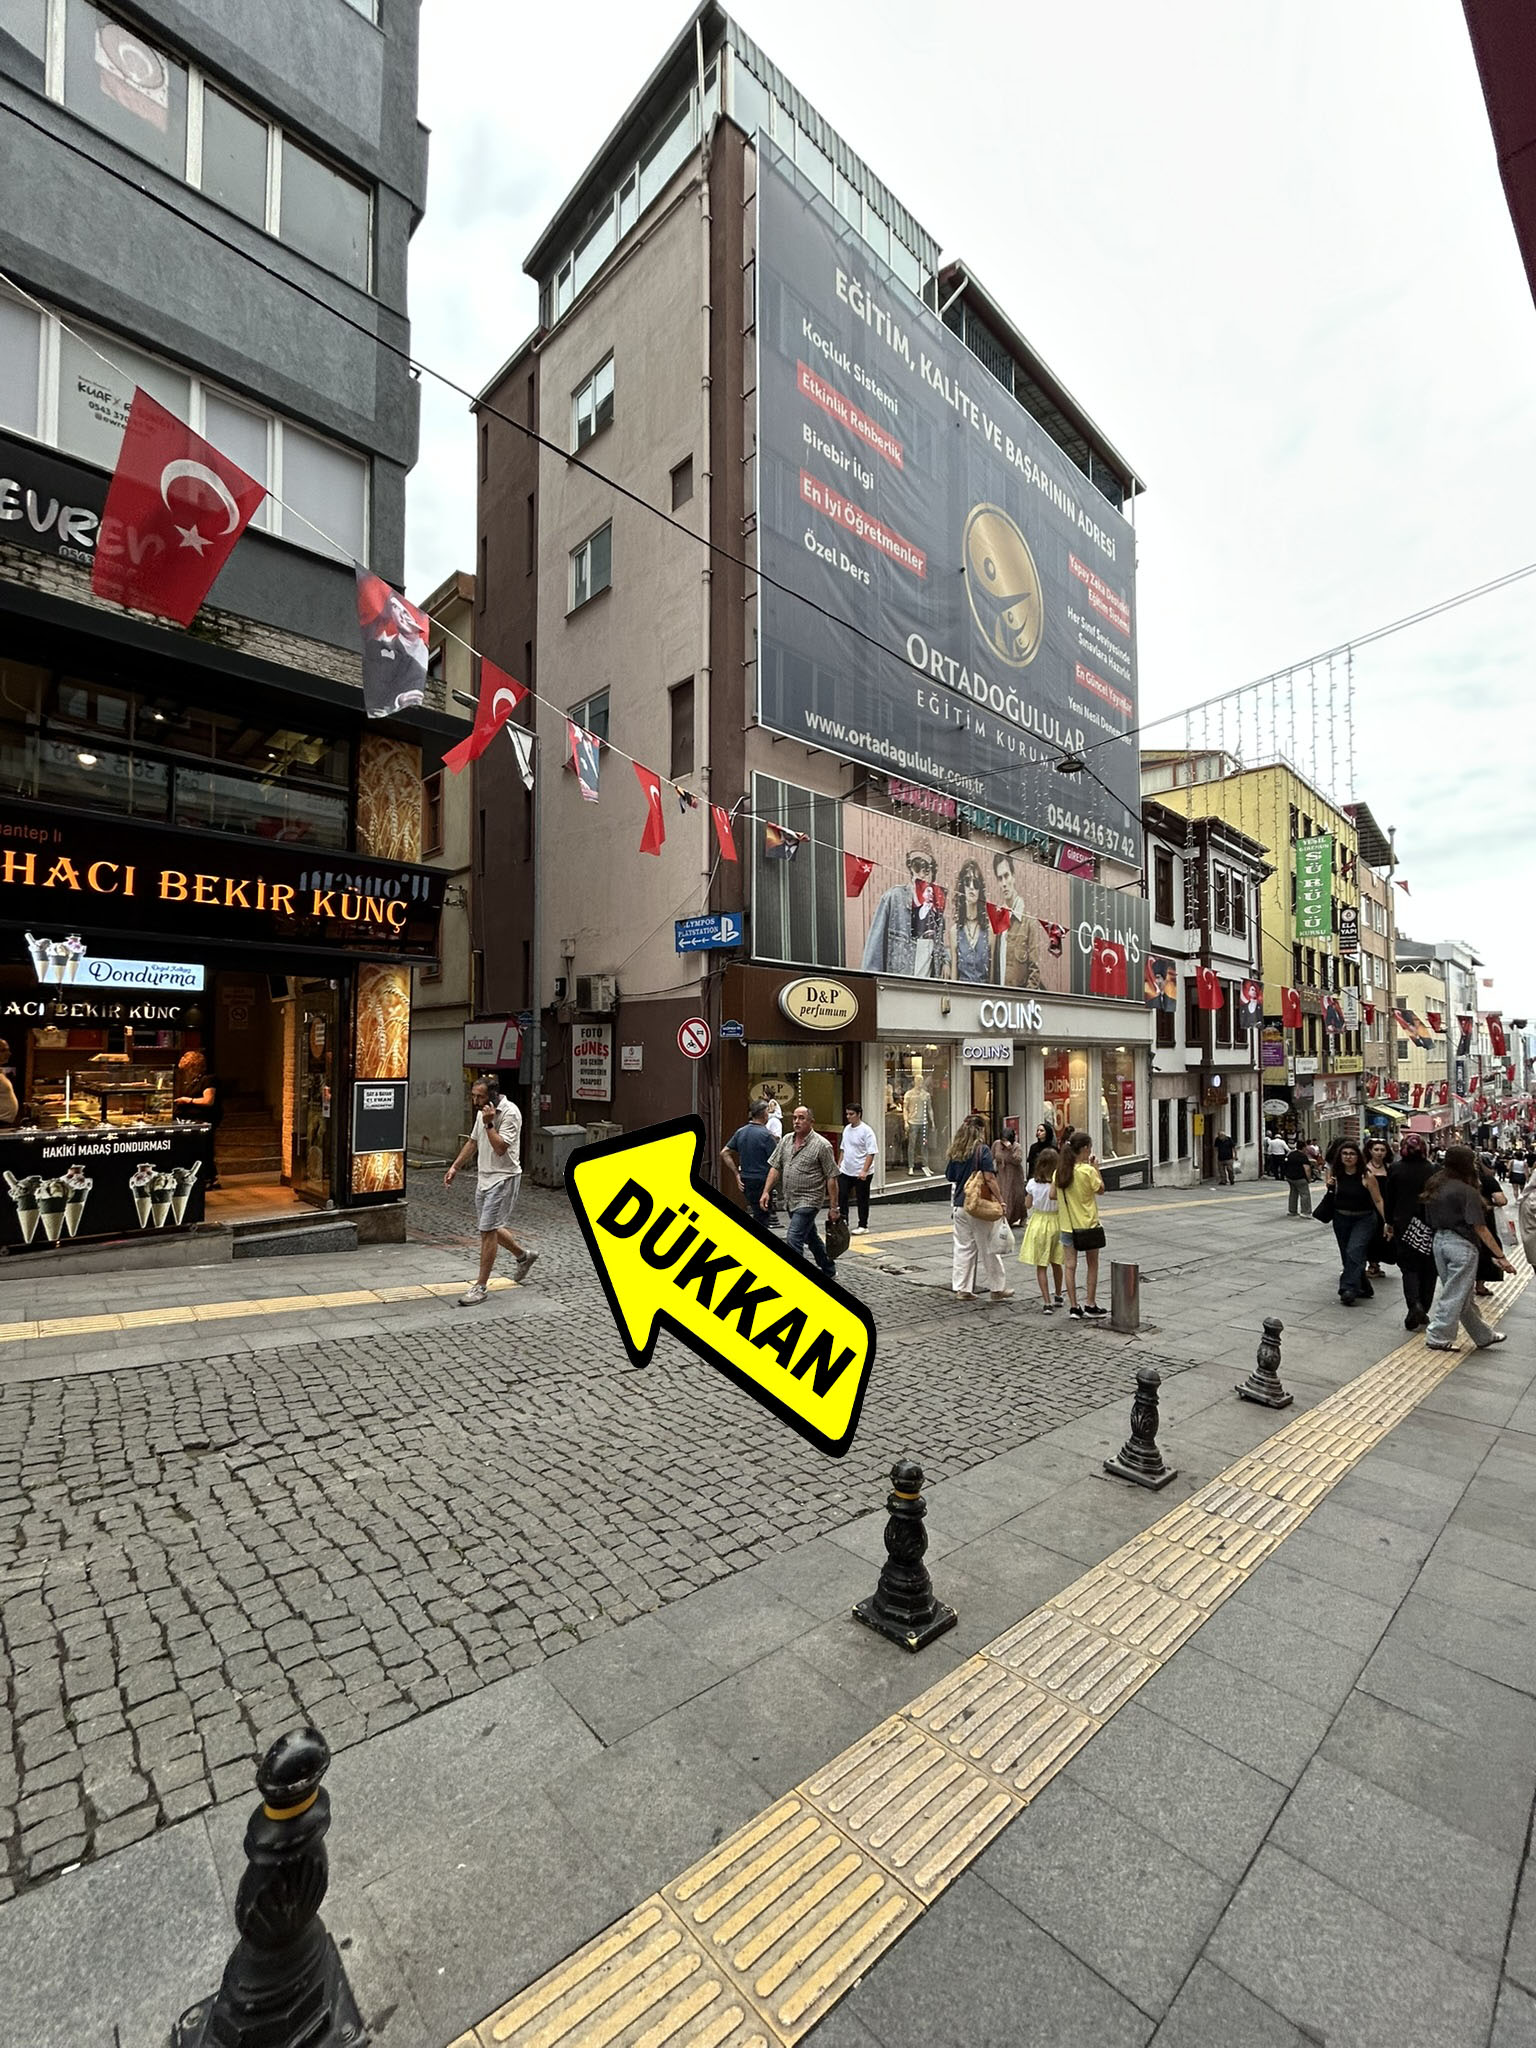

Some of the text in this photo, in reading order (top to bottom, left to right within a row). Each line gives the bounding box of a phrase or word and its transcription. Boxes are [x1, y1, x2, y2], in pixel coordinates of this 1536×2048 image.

[802, 317, 898, 415] Koçluk Sistemi
[802, 372, 902, 463] Etkinlik Rehberlik
[836, 267, 1116, 561] EĞİTİM, KALİTE VE BAŞARININ ADRESİ
[803, 423, 874, 490] Birebir İlgi
[803, 478, 924, 571] En İyi Öğretmenler
[804, 528, 870, 585] Özel Ders
[1069, 553, 1089, 583] Yapay
[1067, 605, 1080, 625] Her
[907, 633, 1087, 758] ORTADOĞULULAR
[1075, 664, 1085, 680] En
[1085, 672, 1108, 697] Güncel
[1068, 695, 1084, 715] Yeni
[1084, 705, 1100, 726] Nesil
[917, 689, 1082, 785] EĞİTİM KURUMLI
[1048, 803, 1080, 836] 0544
[1083, 818, 1104, 846] 216
[1105, 827, 1119, 852] 37
[1122, 835, 1135, 859] 42
[1, 850, 136, 896] HACI
[158, 870, 295, 915] BEKİR
[313, 886, 408, 934] KÜNÇ
[1303, 851, 1323, 928] SÜRÜCÜ
[684, 917, 716, 929] LYMPOS
[89, 961, 196, 987] Dondurma
[0, 1001, 45, 1016] ACI
[800, 1004, 847, 1018] perfumum
[807, 987, 840, 1004] D&P
[980, 1000, 1042, 1030] COLIN'S
[581, 1028, 602, 1038] FOTO
[574, 1039, 609, 1059] GÜNEŞ
[963, 1045, 1011, 1060] COLIN'S
[42, 1139, 171, 1158] HAKİKİ MARAŞ DONDURMASI
